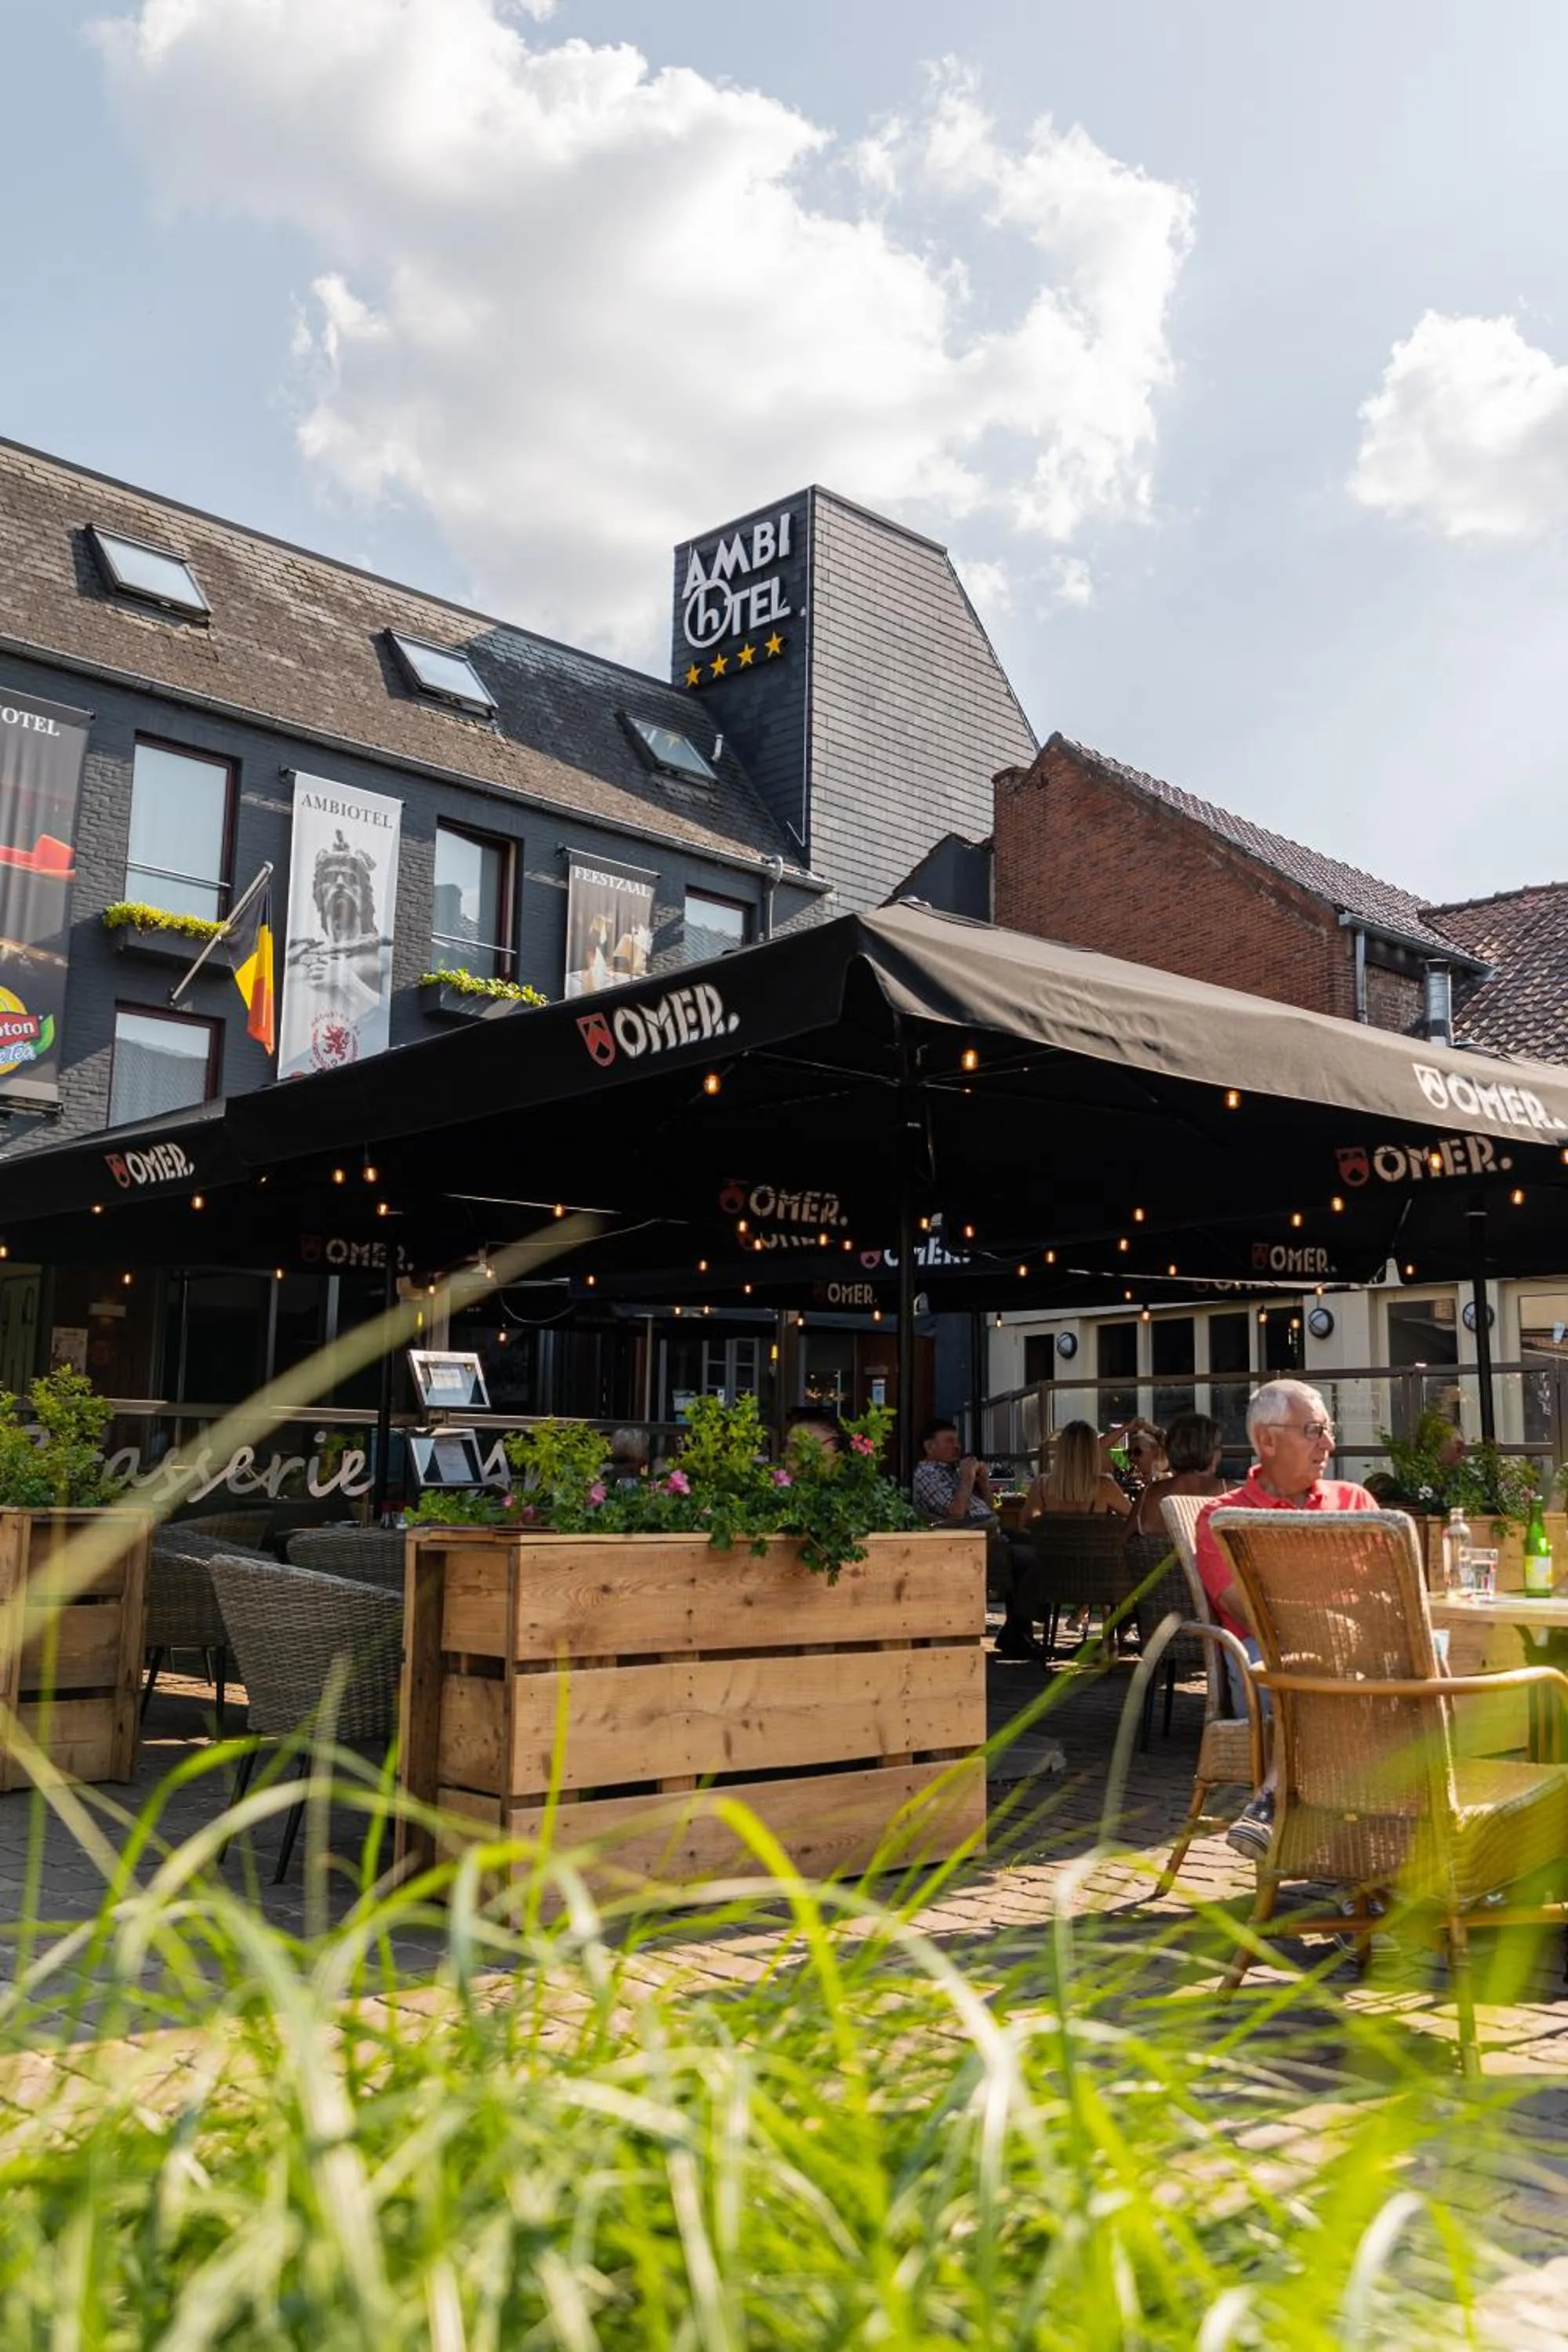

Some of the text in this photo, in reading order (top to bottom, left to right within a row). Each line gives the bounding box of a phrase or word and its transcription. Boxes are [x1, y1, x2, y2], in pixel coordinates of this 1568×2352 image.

[682, 512, 791, 599] AMBI
[0, 705, 60, 737] OTEL
[301, 793, 393, 829] AMBIOTEL
[572, 865, 651, 898] FEESTZAAL
[22, 1423, 376, 1504] asserie
